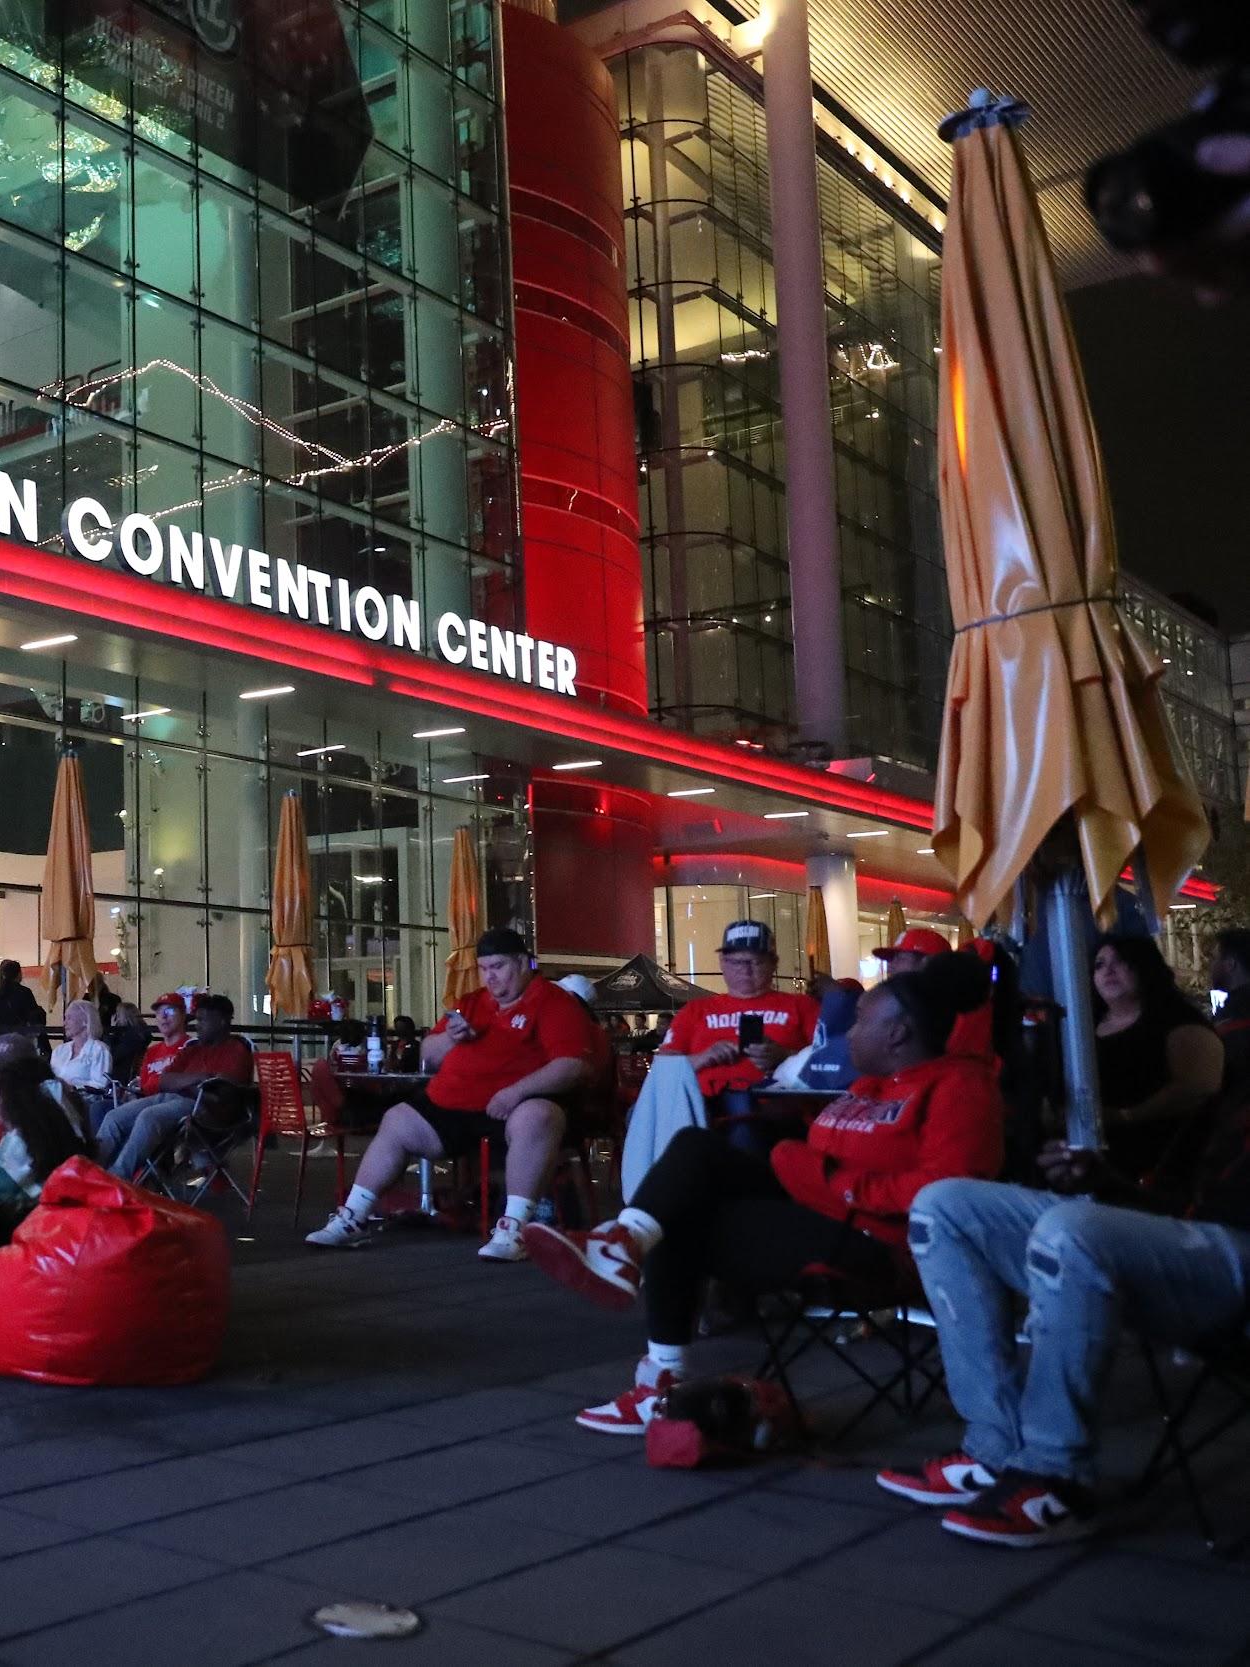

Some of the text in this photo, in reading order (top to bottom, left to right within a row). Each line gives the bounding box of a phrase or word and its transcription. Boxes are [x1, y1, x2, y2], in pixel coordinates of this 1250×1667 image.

[178, 89, 213, 125] APRIL
[216, 110, 226, 131] 2
[186, 67, 235, 113] GREEN
[65, 496, 423, 652] CONVENTION
[436, 611, 578, 697] CENTER
[706, 1010, 789, 1029] HOUON
